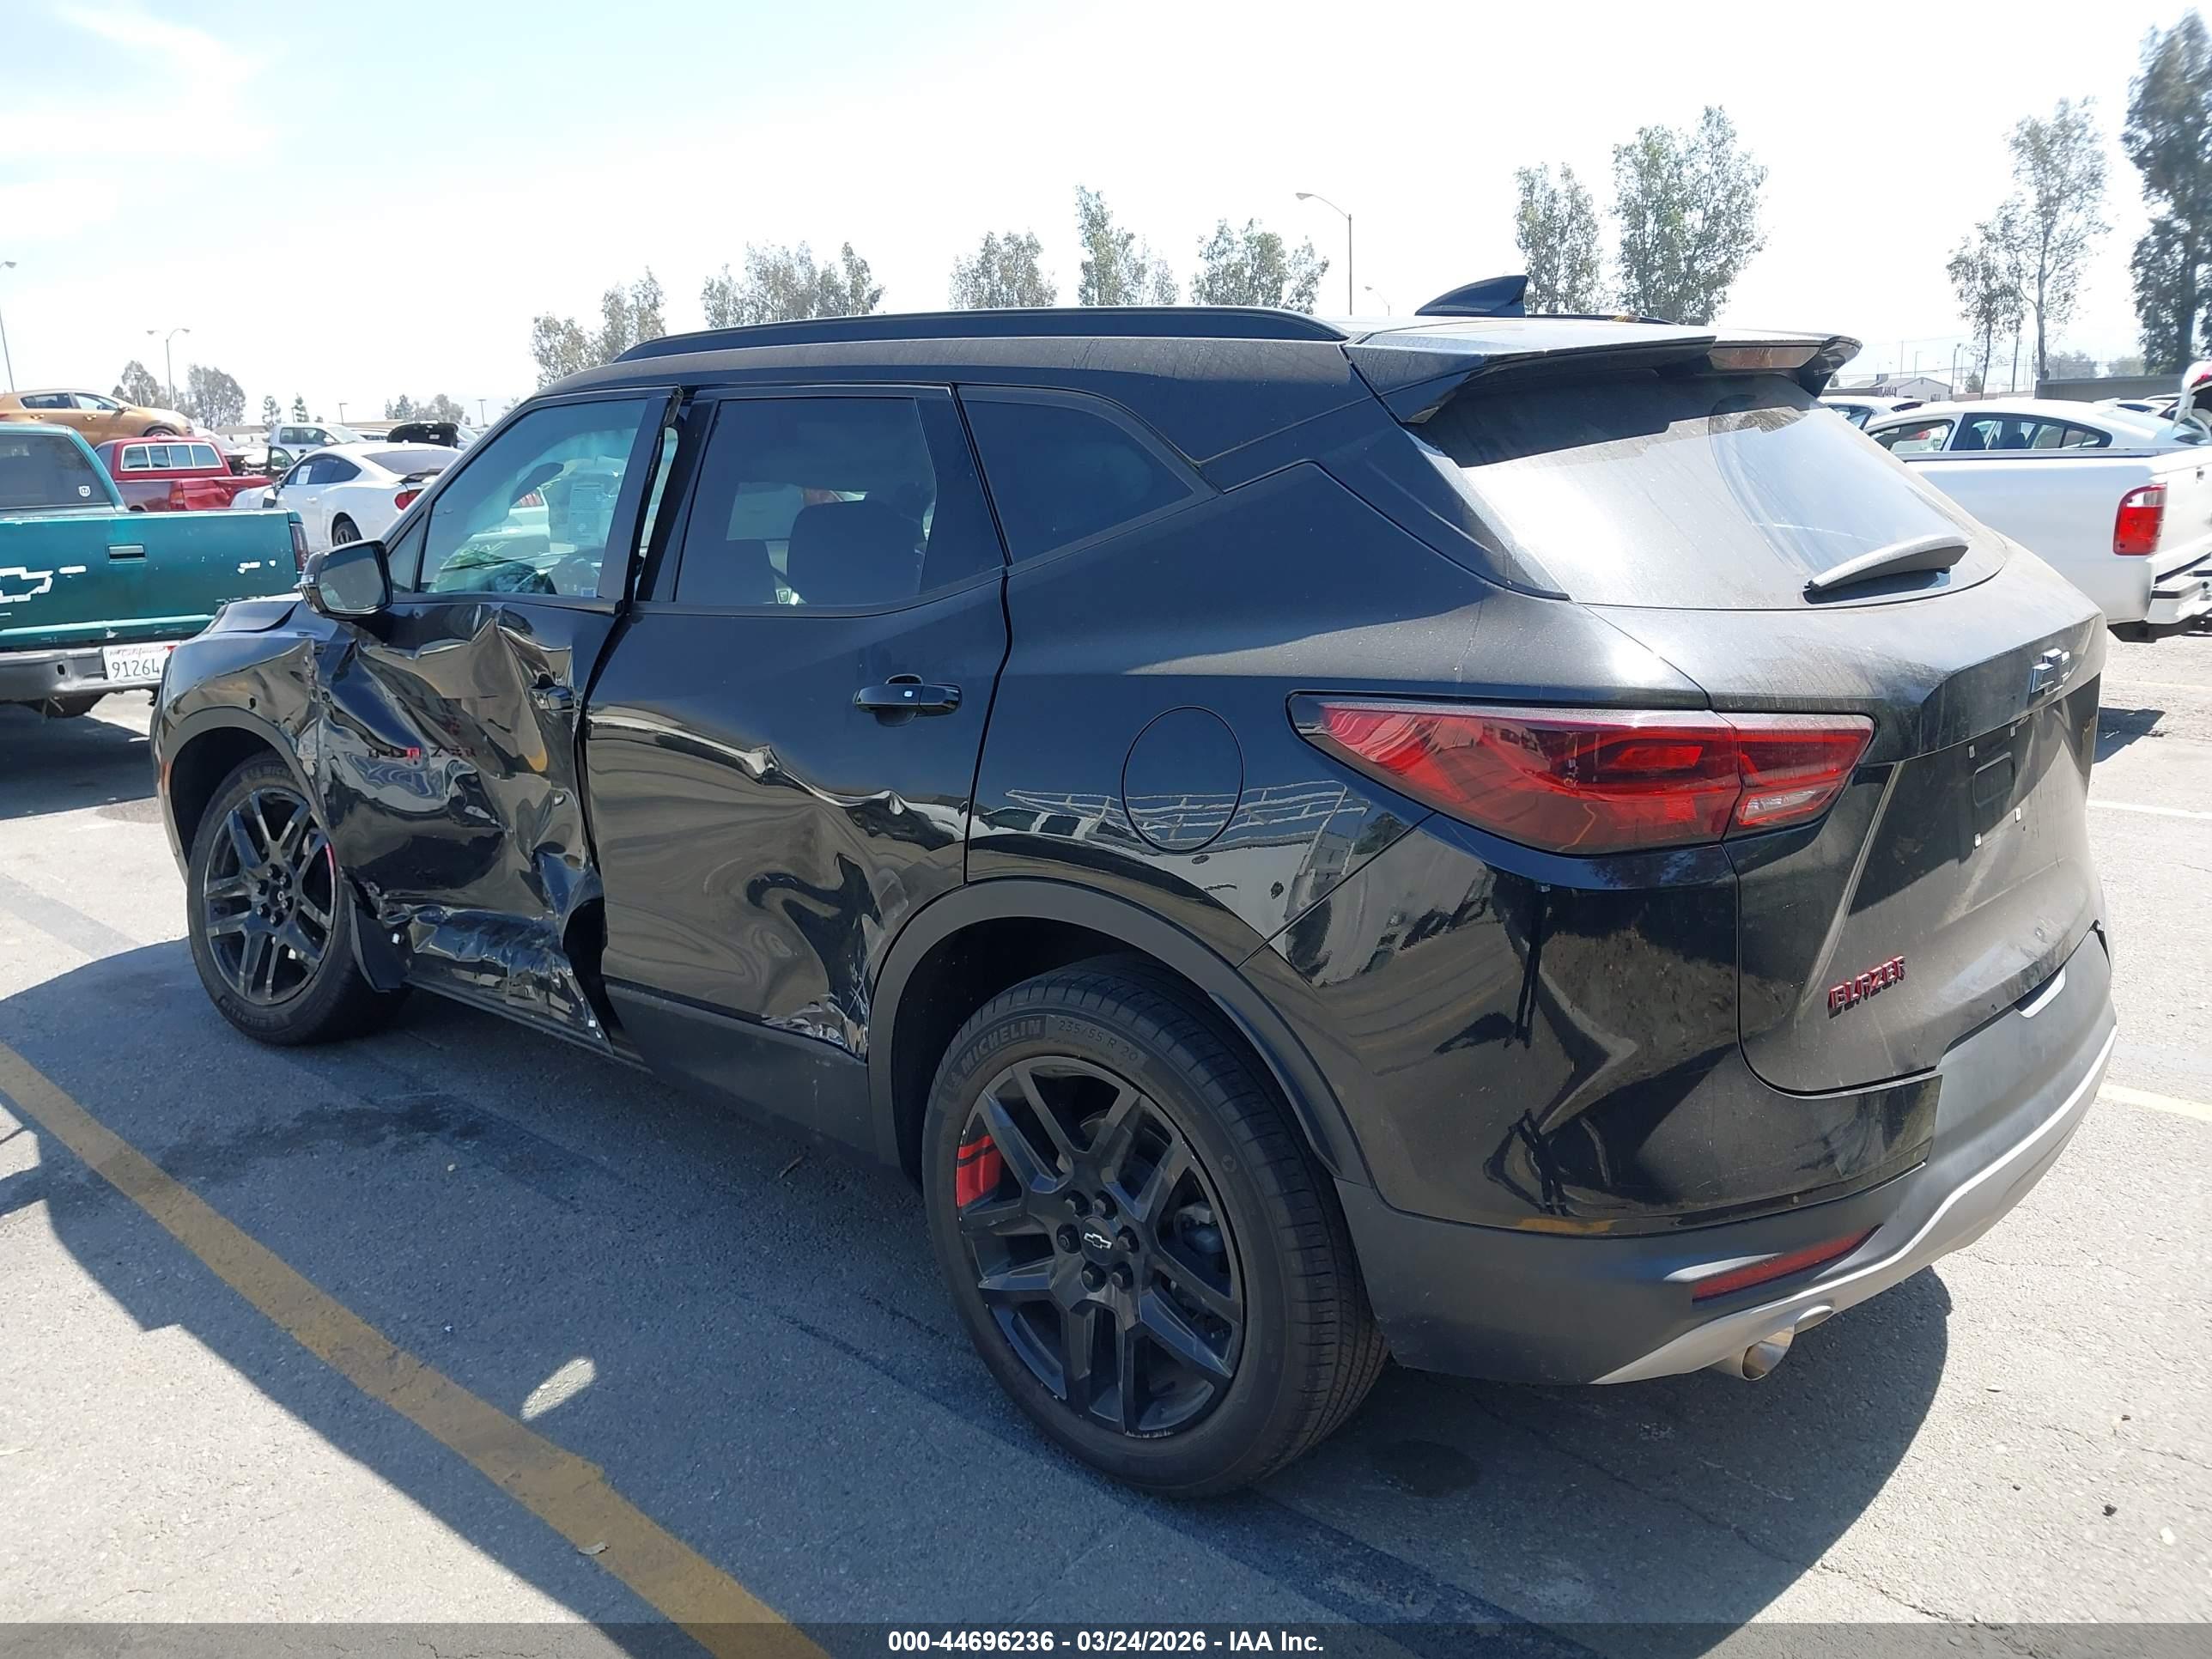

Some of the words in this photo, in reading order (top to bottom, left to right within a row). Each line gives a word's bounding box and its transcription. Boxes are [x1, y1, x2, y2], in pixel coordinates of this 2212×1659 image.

[962, 1019, 1042, 1074] MICHELIN
[1058, 1020, 1103, 1042] 235/55
[1107, 1037, 1117, 1049] R
[1122, 1046, 1139, 1060] 20
